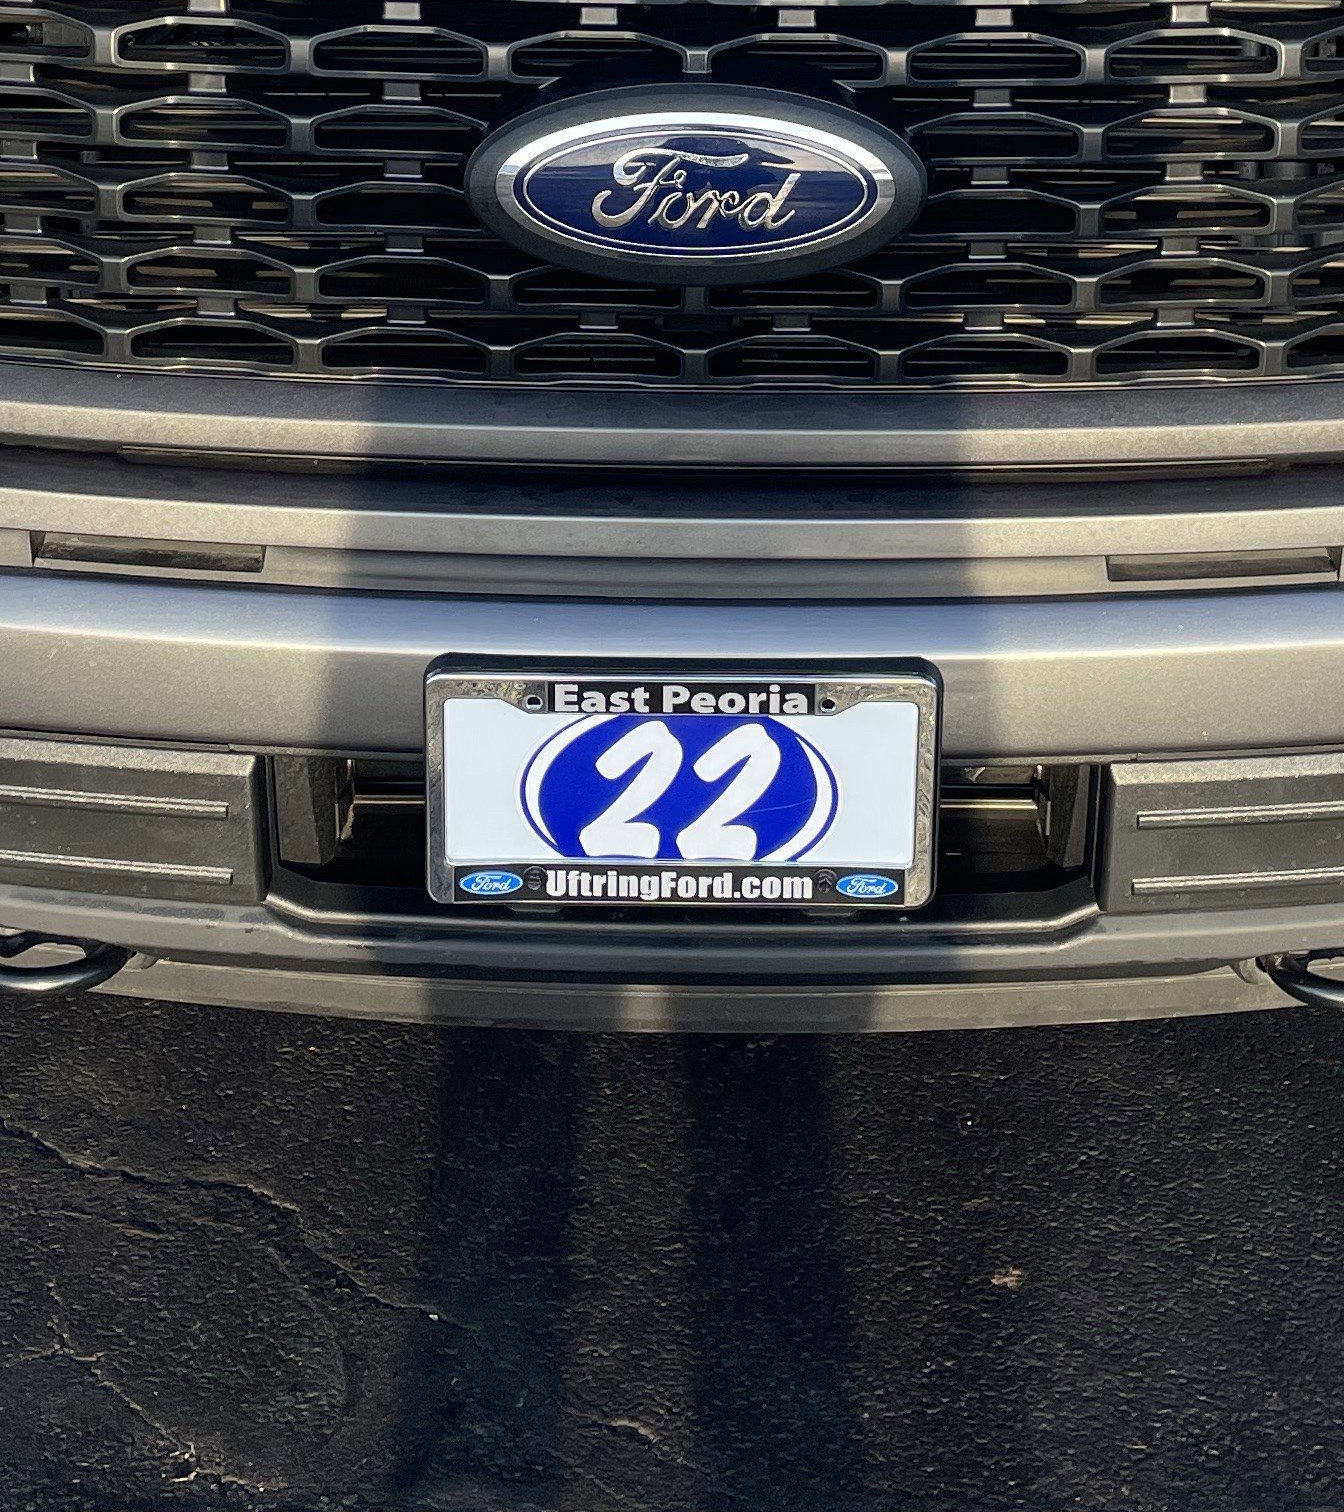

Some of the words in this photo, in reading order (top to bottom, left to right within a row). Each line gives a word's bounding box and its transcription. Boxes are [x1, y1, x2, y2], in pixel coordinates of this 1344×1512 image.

[591, 147, 801, 229] Ford
[554, 683, 650, 714] East
[662, 684, 808, 714] Peoria
[578, 721, 782, 860] 22
[545, 869, 813, 901] UftringFord.com
